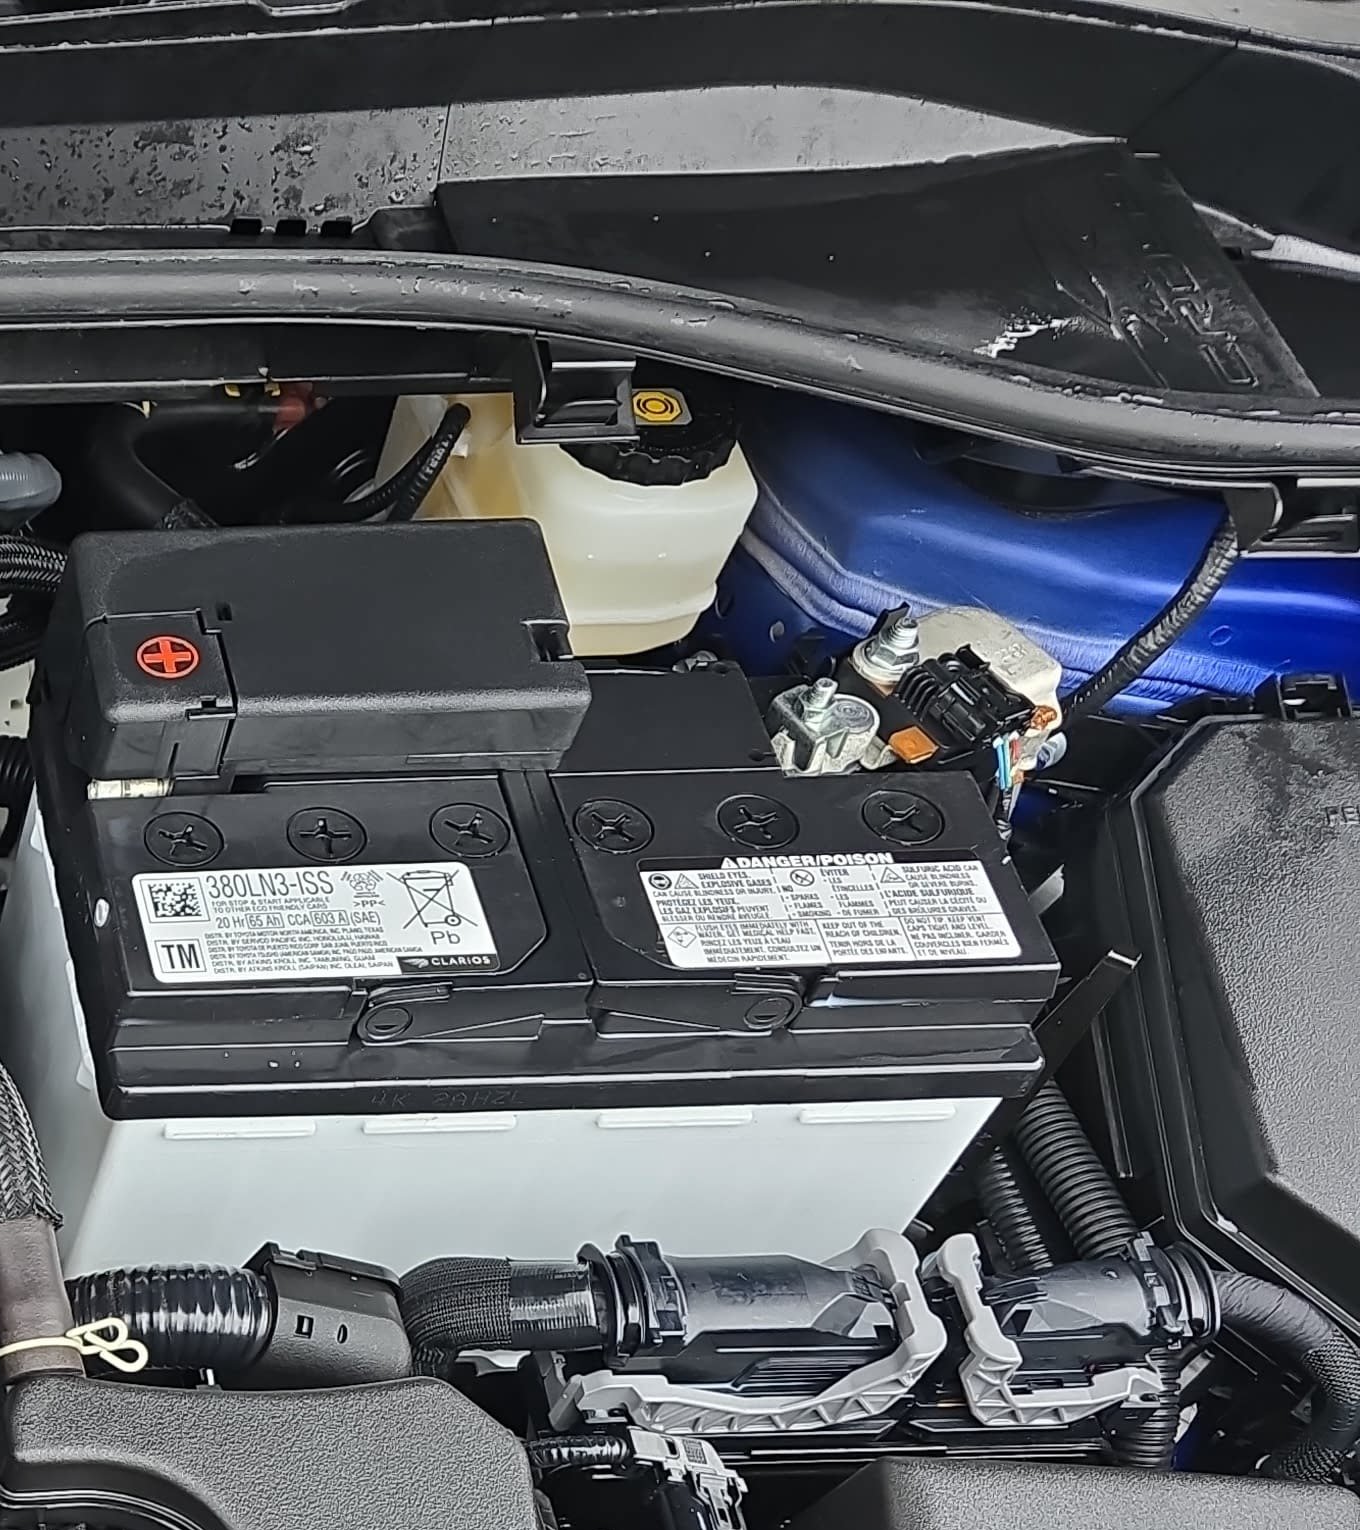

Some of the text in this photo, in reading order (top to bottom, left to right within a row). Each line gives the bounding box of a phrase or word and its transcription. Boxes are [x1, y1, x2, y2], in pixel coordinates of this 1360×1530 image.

[737, 852, 893, 868] DANGER/POISON
[203, 870, 335, 899] 380LN3-ISS
[214, 910, 381, 928] 20 Hr 65 Ah CCA 603 A (SAE)
[431, 930, 461, 947] Pb
[161, 943, 201, 970] TM
[431, 955, 491, 968] CLARIOS
